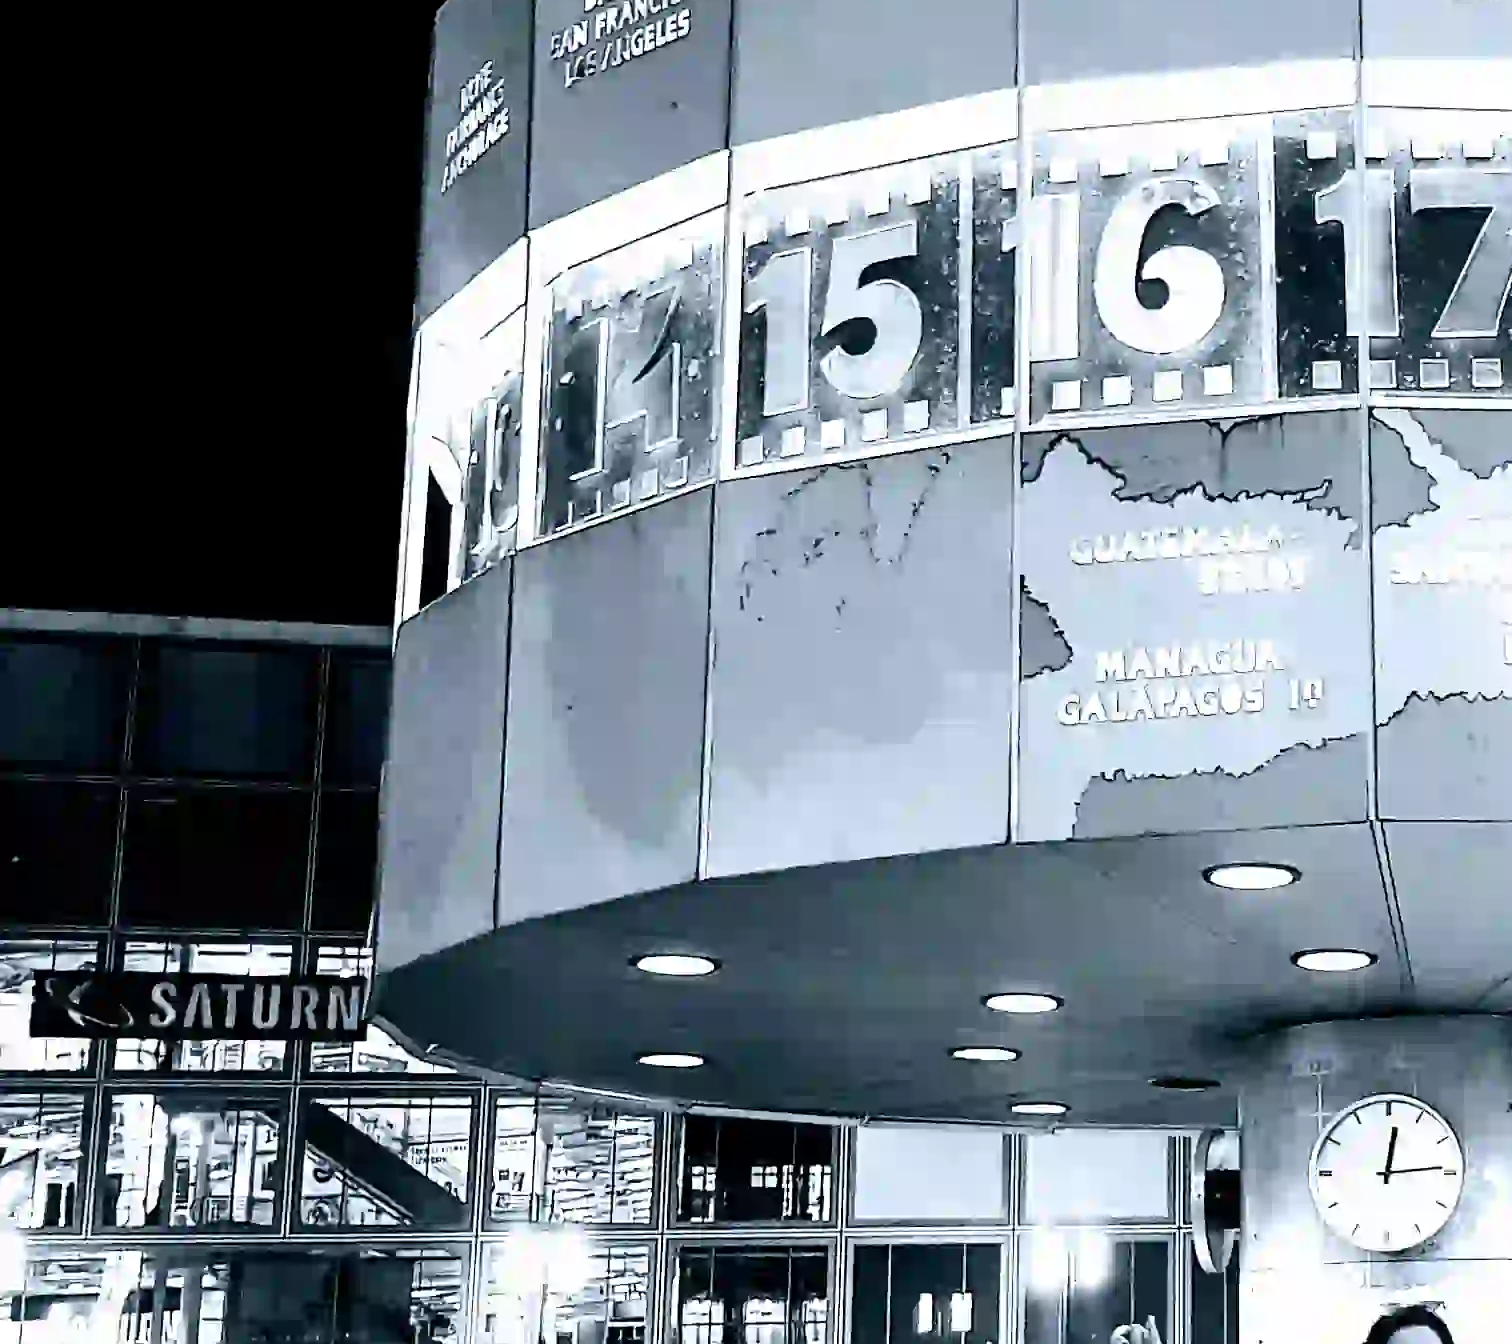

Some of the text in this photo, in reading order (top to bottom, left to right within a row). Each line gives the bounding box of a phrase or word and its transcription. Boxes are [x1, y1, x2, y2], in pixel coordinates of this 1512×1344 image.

[550, 18, 590, 60] SAN
[742, 217, 925, 418] 15
[1002, 176, 1226, 362] 16
[149, 981, 361, 1032] SATURN
